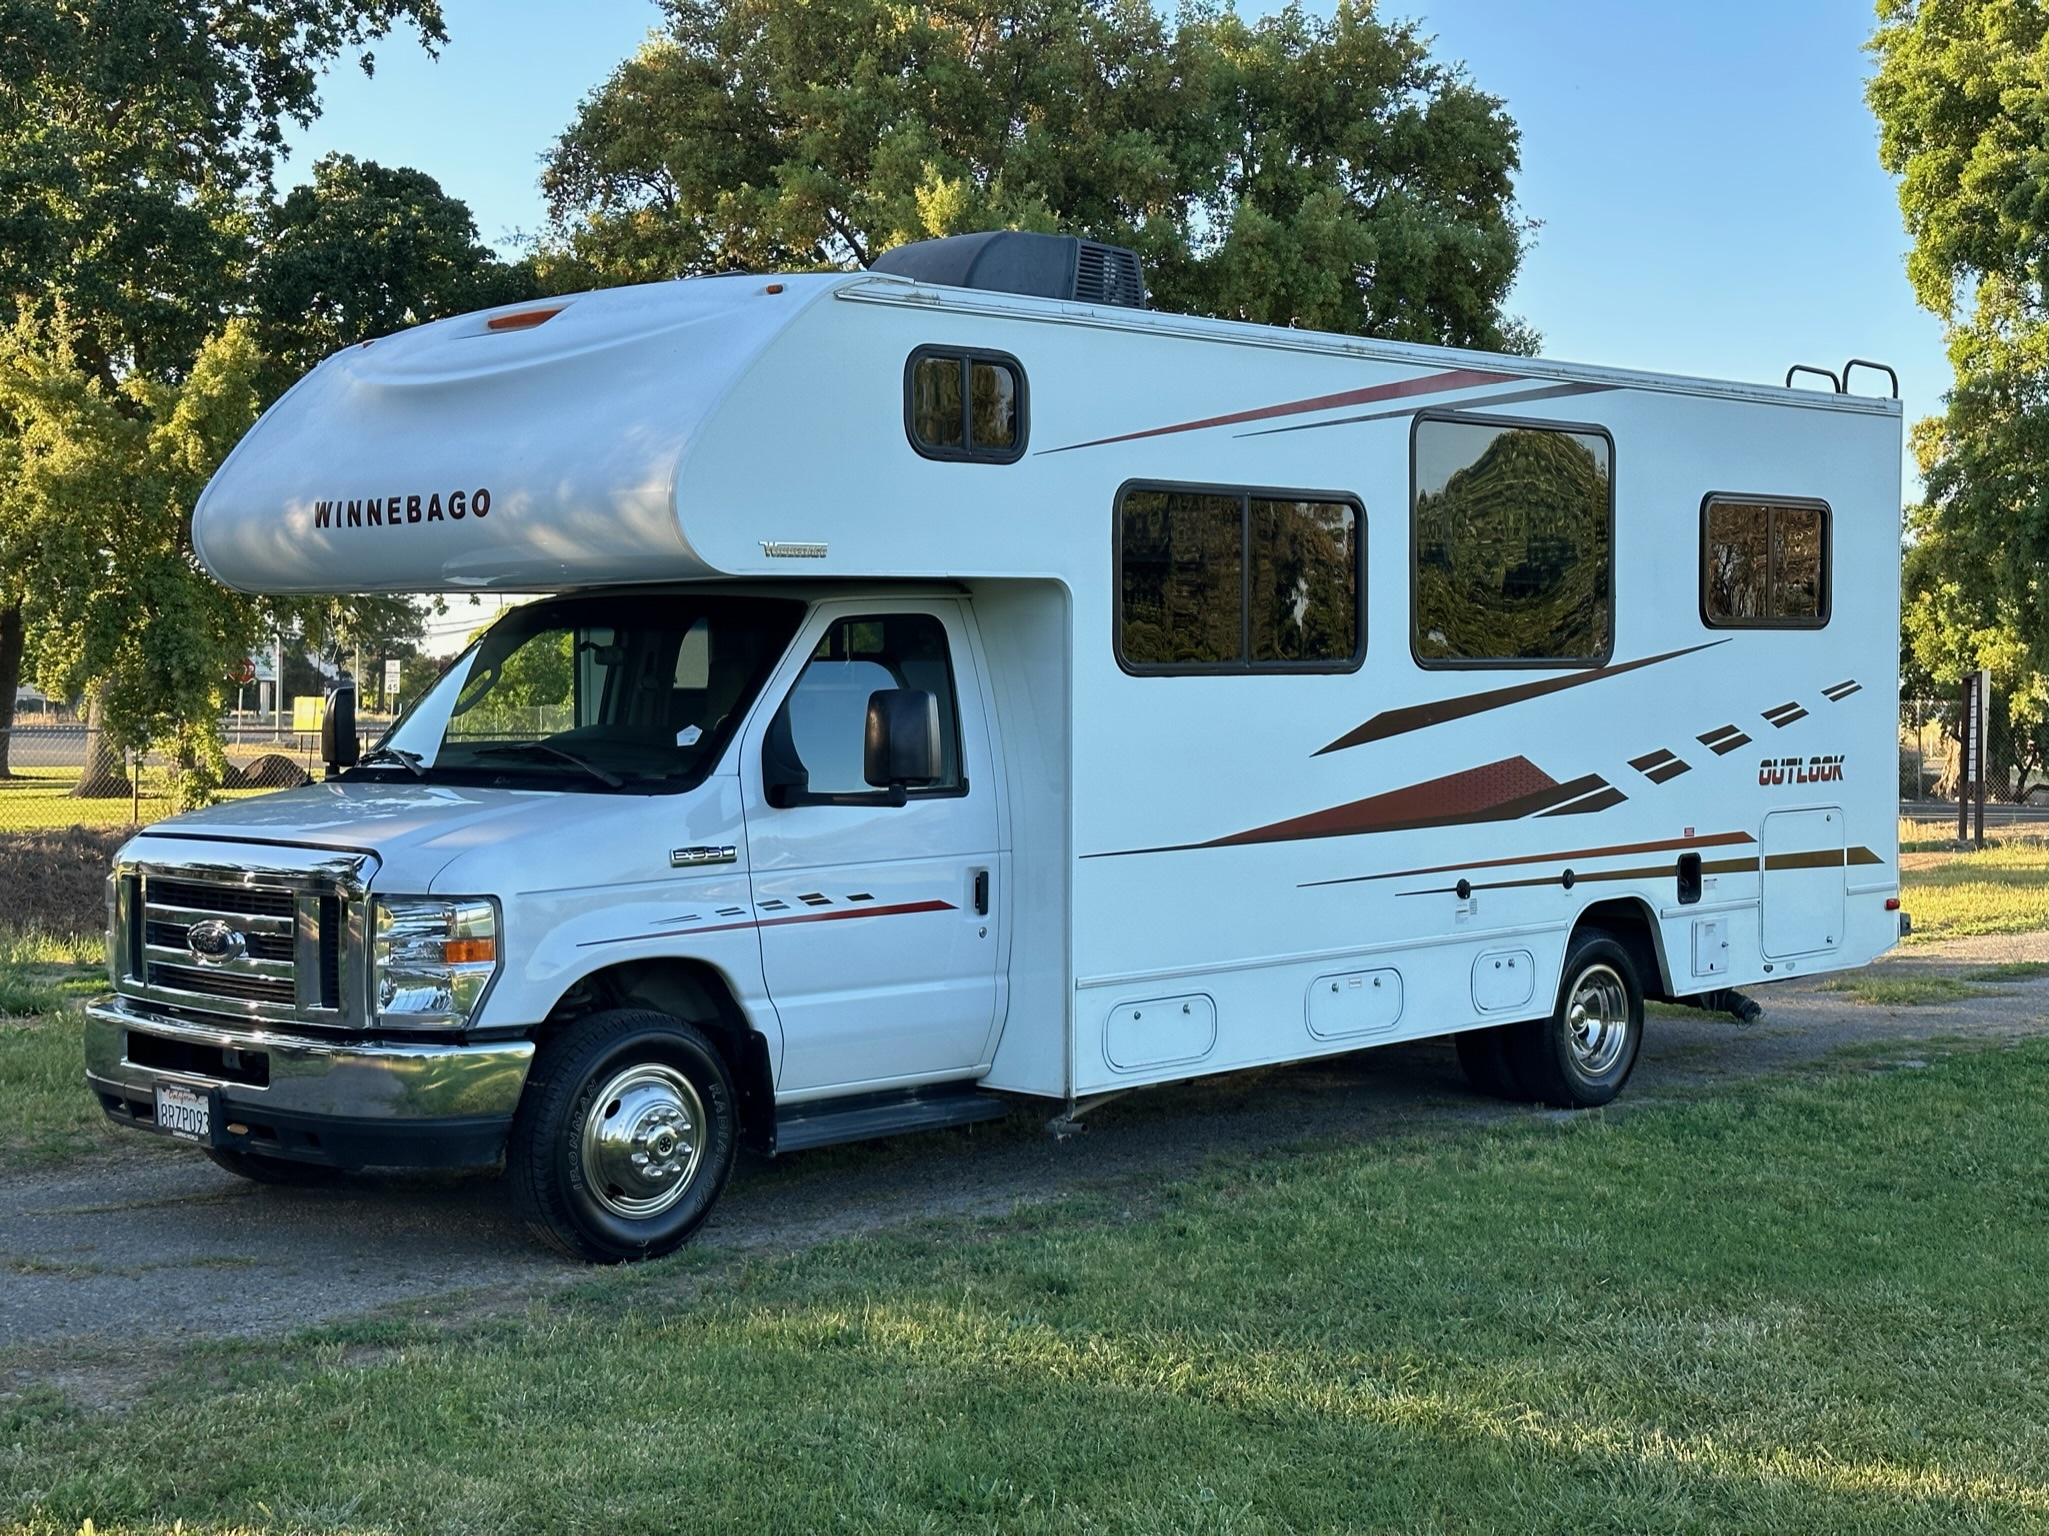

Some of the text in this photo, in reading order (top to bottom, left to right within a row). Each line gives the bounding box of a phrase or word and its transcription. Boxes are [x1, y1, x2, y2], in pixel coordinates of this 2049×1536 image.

[315, 488, 491, 528] WINNEBAGO
[1759, 755, 1845, 785] OUTLOOK
[197, 931, 220, 952] Ford
[161, 1103, 211, 1135] 8RZP093
[568, 1079, 598, 1191] IRONMAN
[708, 1083, 729, 1164] RADIAL
